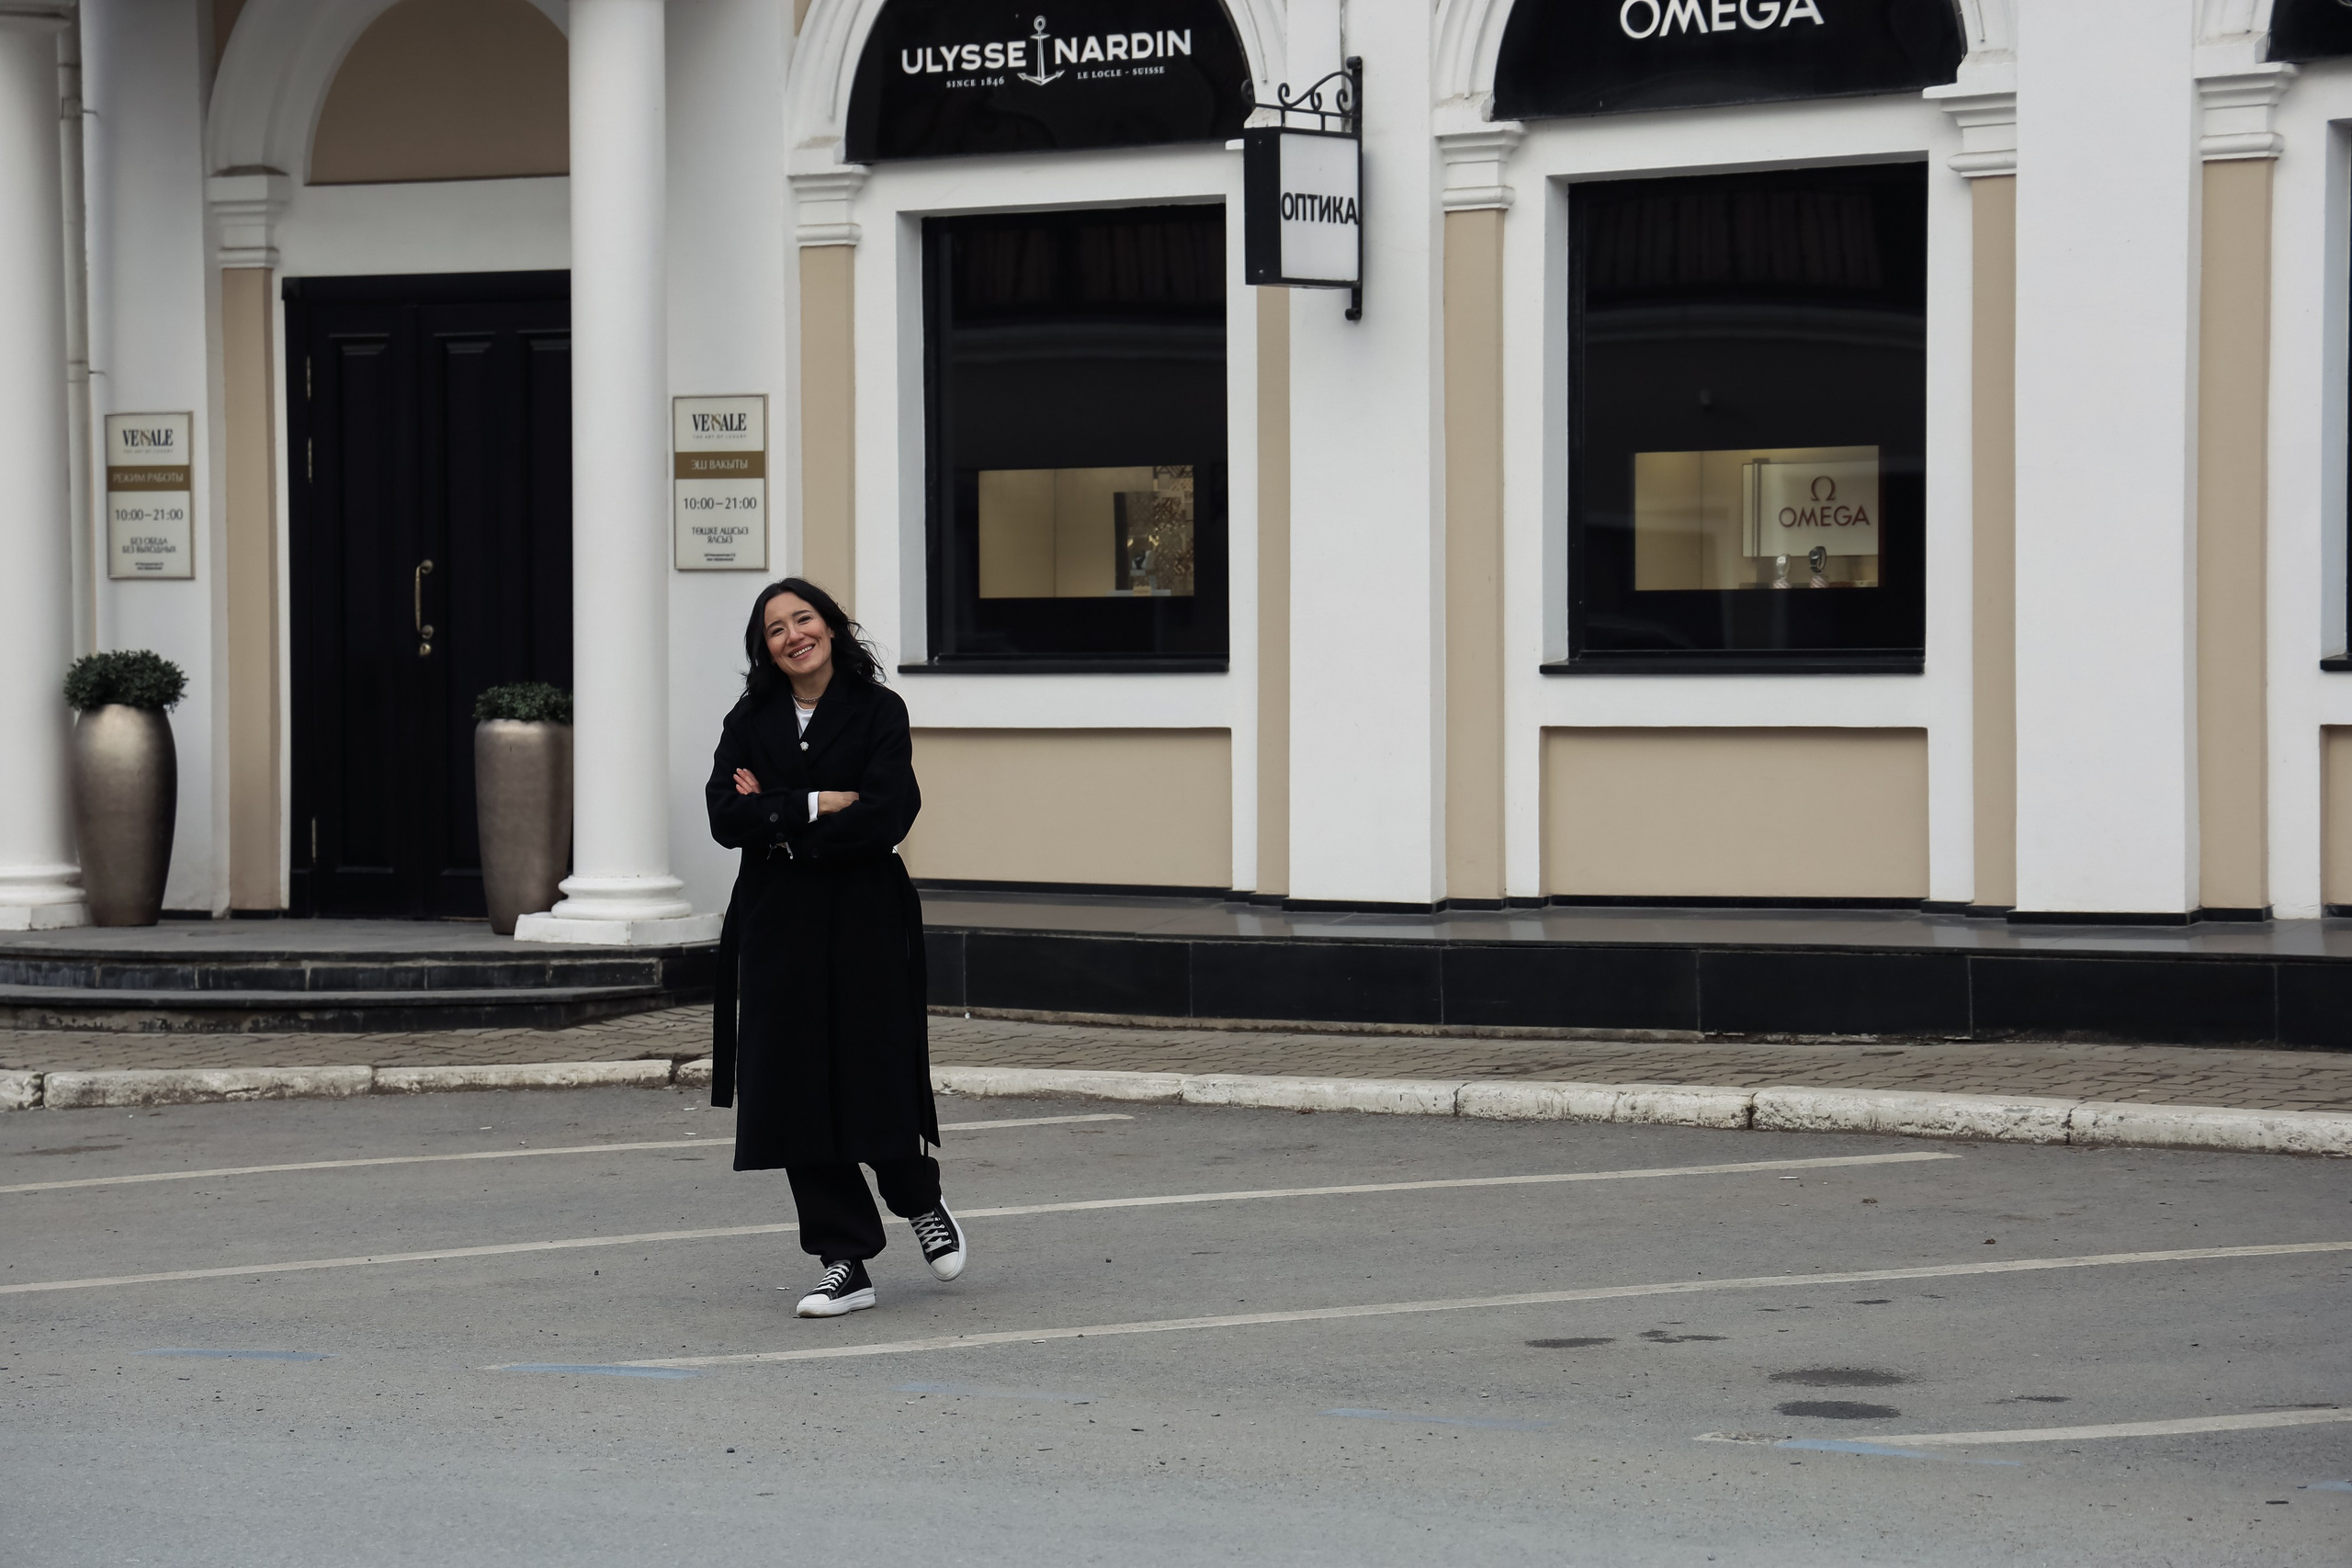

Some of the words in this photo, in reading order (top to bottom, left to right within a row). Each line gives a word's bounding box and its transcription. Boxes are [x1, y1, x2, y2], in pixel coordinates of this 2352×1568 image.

[1620, 0, 1825, 39] OMEGA
[900, 40, 1027, 74] ULYSSE
[1054, 28, 1192, 64] NARDIN
[945, 78, 977, 88] SINCE
[980, 75, 1005, 87] 1846
[1077, 72, 1089, 80] LE
[1091, 69, 1123, 79] LOCLE
[1132, 66, 1166, 76] SUISSE
[1281, 192, 1360, 225] ОПТИКА
[691, 459, 707, 470] ЭШ
[709, 458, 749, 469] ВАКЫТЫ
[112, 472, 145, 483] РЕЖИМ
[147, 472, 184, 483] РАБОТЫ
[1778, 504, 1871, 527] OMEGA
